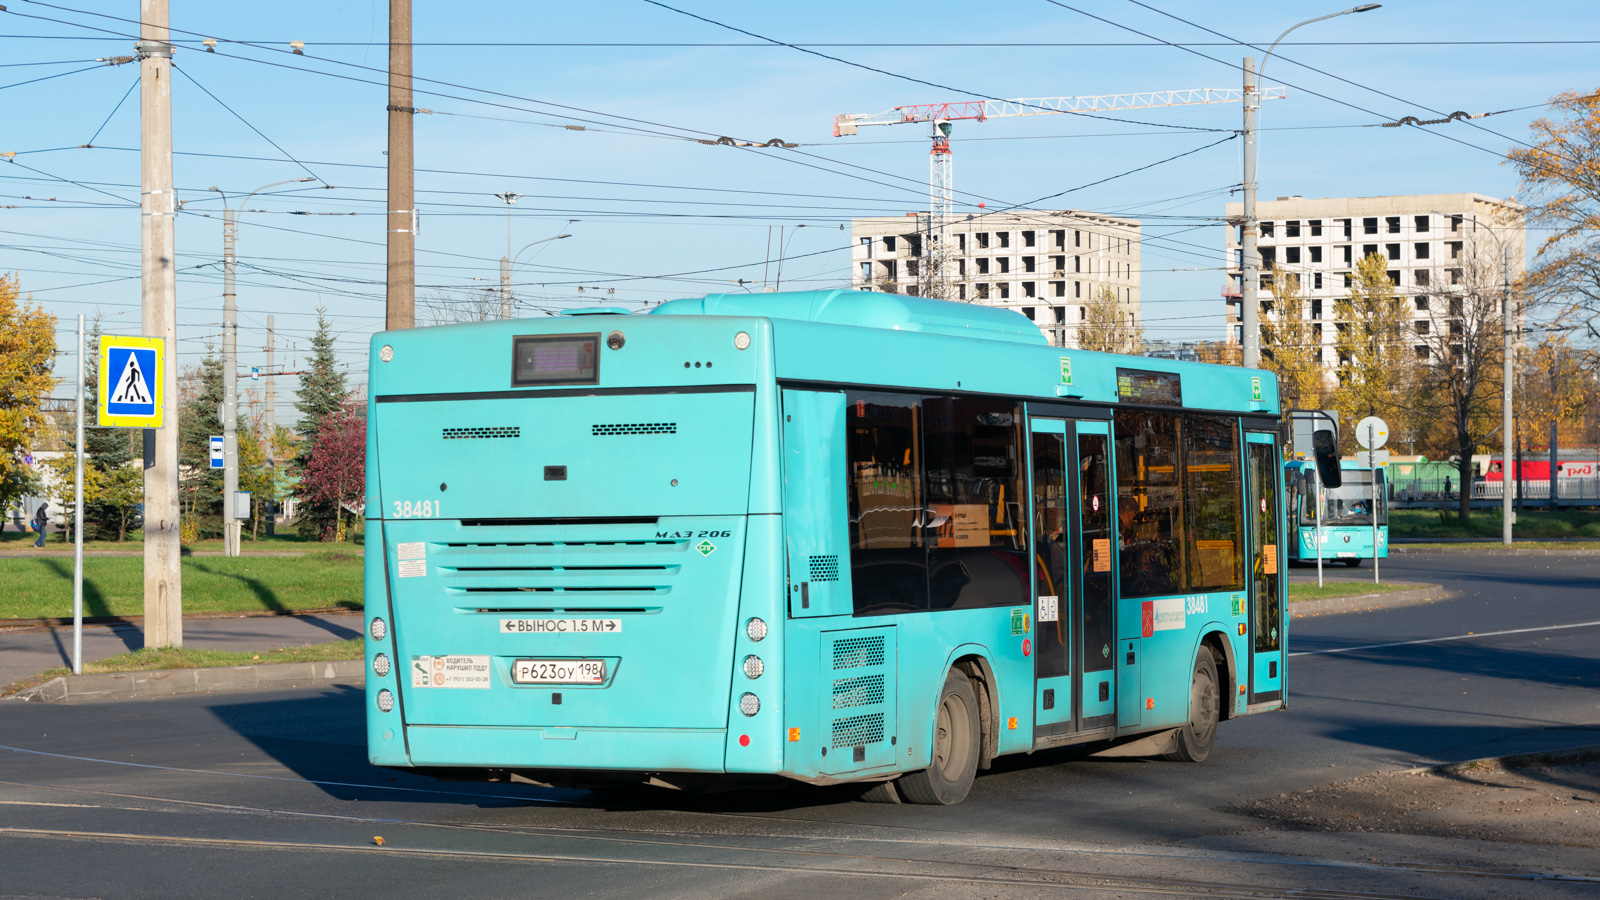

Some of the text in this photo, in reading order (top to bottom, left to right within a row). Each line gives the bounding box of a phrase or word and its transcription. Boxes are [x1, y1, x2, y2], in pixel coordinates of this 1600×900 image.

[392, 500, 440, 518] 38481
[697, 530, 732, 538] 206
[698, 544, 712, 552] СПГ
[1186, 595, 1209, 615] 38481
[517, 619, 604, 632] ВЫНОС 1.5 М
[578, 663, 599, 675] 198
